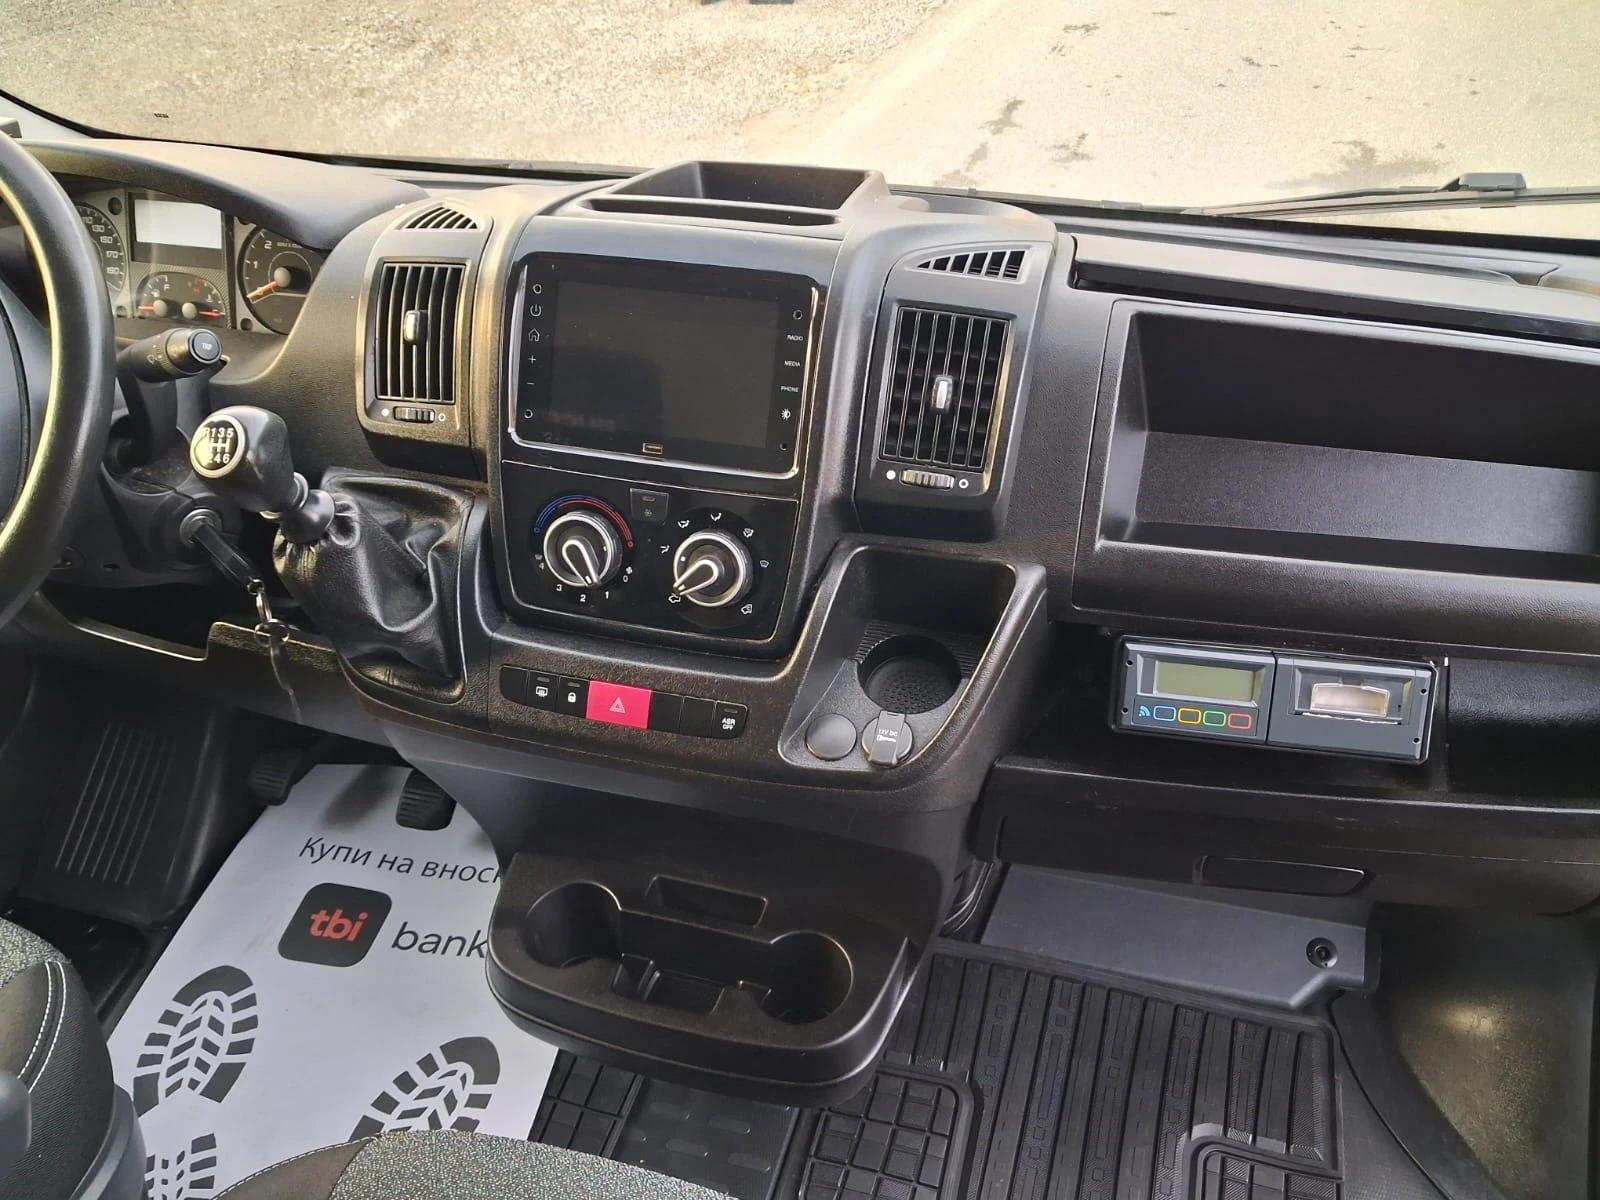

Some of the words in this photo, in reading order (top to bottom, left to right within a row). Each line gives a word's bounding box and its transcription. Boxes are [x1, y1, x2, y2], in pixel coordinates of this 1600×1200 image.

[264, 240, 272, 249] 2
[784, 359, 801, 367] MEDIA
[780, 385, 799, 393] PHONE
[556, 583, 563, 592] 3
[580, 594, 587, 602] 2
[721, 717, 736, 726] ASR
[299, 837, 372, 866] Купи
[377, 853, 414, 874] на
[309, 908, 369, 942] tbi
[391, 921, 488, 958] bank
